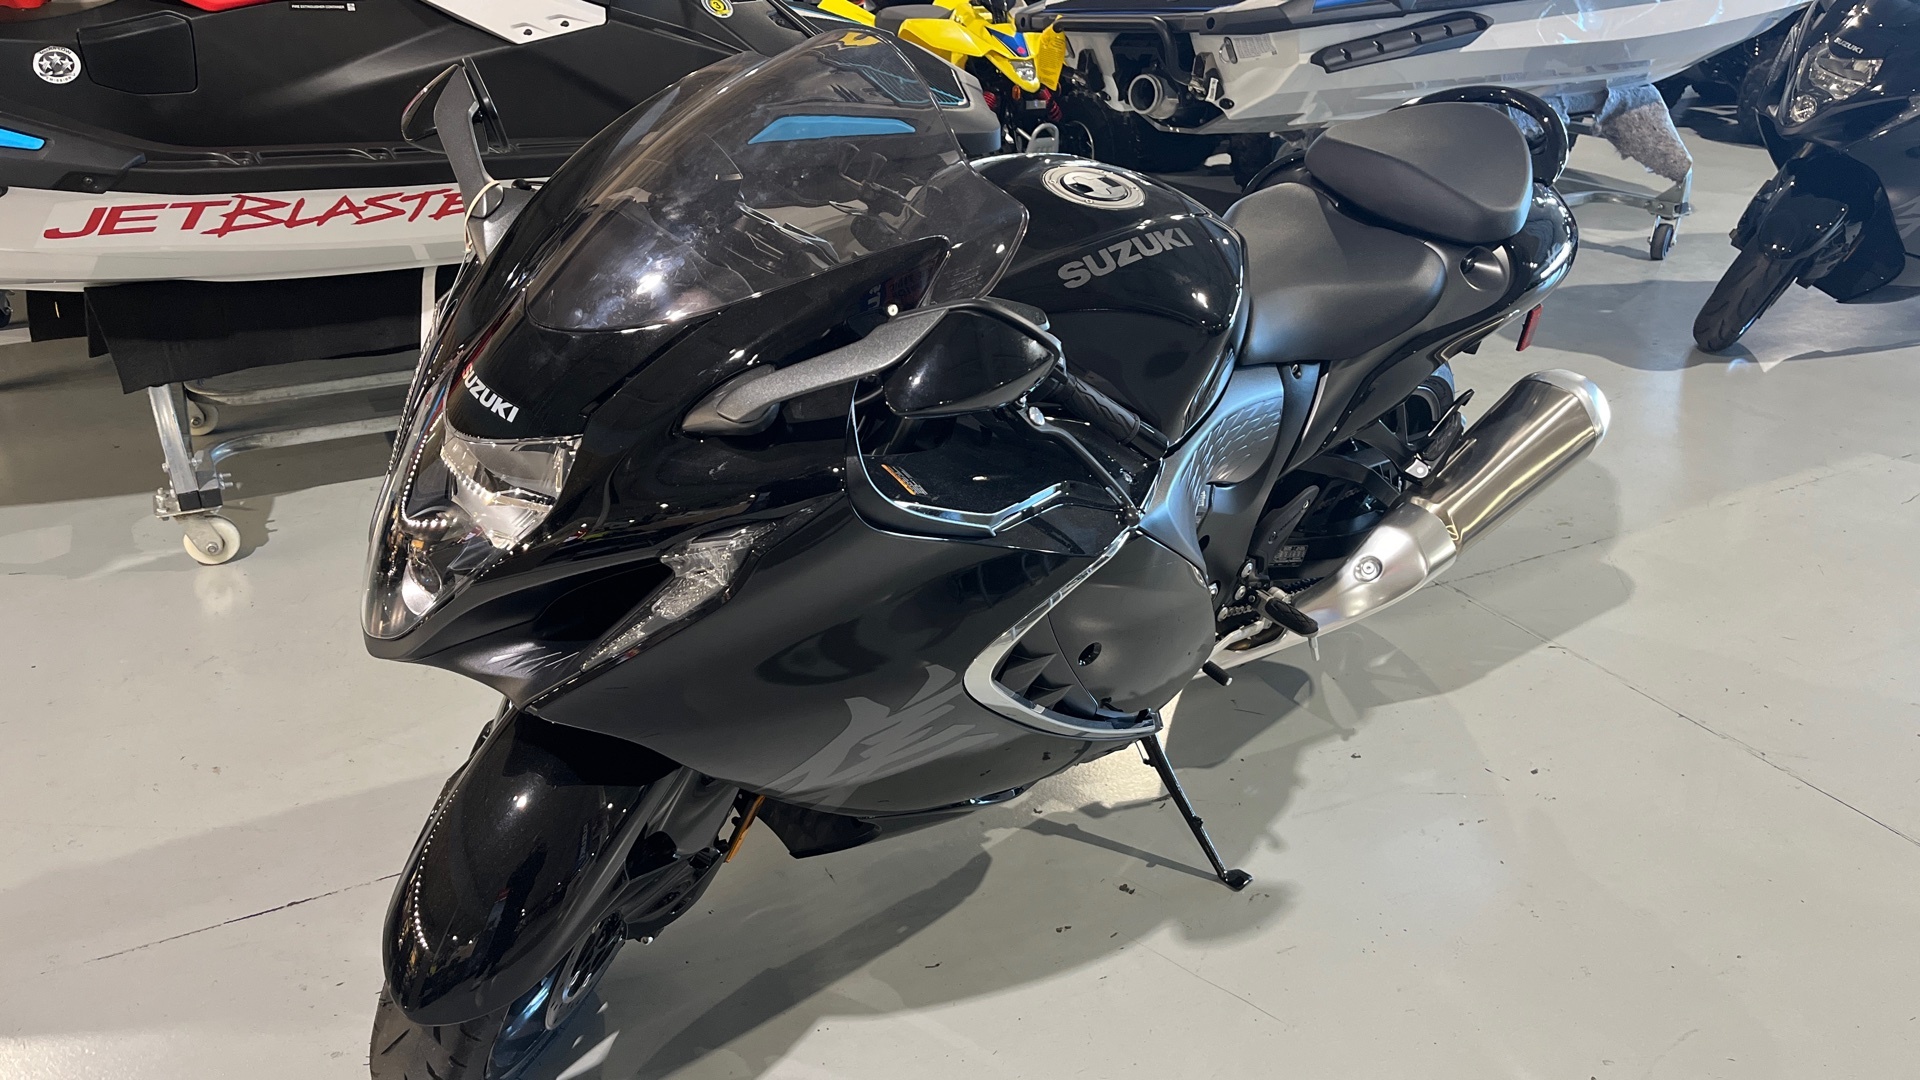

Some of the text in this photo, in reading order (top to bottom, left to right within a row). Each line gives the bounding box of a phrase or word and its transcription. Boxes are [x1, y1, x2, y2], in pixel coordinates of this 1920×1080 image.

[1834, 37, 1863, 54] SUZUKI
[43, 188, 465, 239] JETBLASTE
[1057, 227, 1194, 289] SUZUKI
[461, 362, 520, 423] SUZUKI
